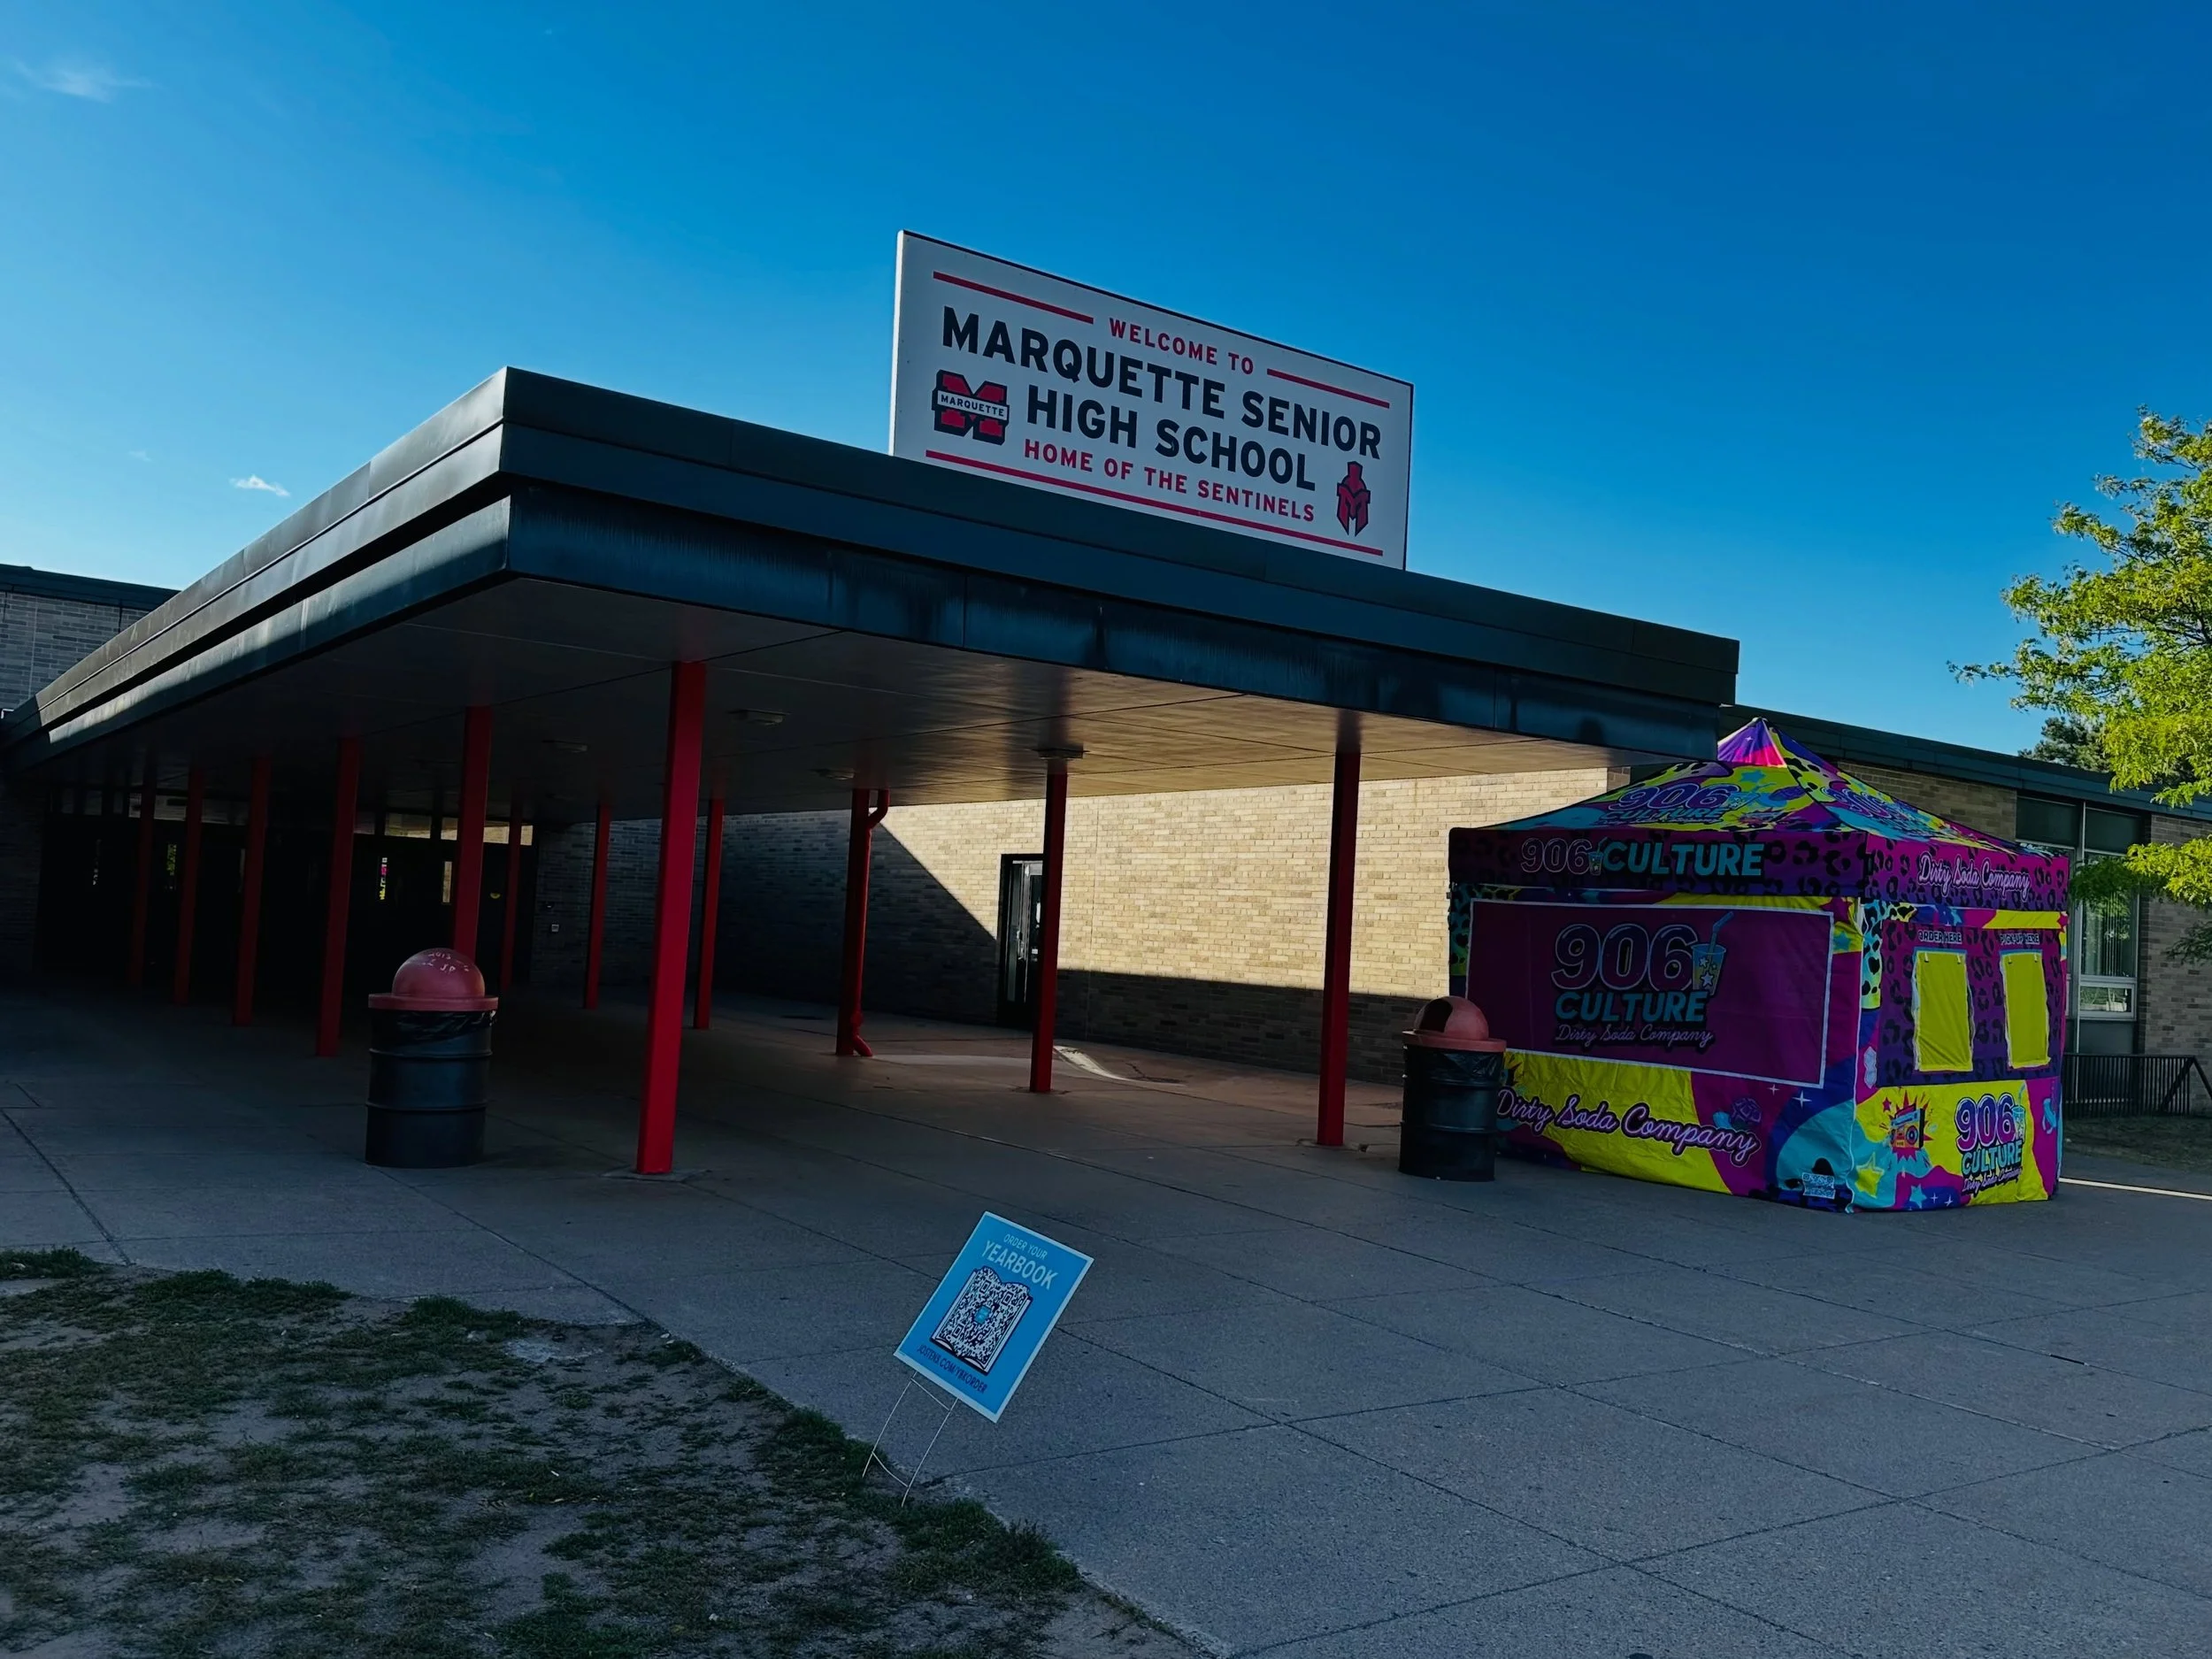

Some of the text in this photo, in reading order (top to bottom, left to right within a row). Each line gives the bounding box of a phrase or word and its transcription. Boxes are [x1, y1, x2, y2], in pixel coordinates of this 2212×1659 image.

[1109, 318, 1254, 375] WELCOME TO
[941, 394, 1004, 417] MARQUETTE
[942, 305, 1381, 459] MARQUETTE SENIOR
[1027, 384, 1316, 491] HIGH SCHOOL
[1025, 439, 1315, 522] HOME OF THE SENTINELS
[1609, 783, 1740, 810] 906
[1520, 836, 1766, 877] 906 CULTURE
[1917, 854, 2031, 900] Dirty Soda Company
[1550, 923, 1698, 991] 906
[1554, 990, 1709, 1022] CULTURE
[1555, 1024, 1714, 1048] Dirty Soda Company
[1495, 1087, 1759, 1163] Dirty Soda Company
[1955, 1094, 2016, 1152] 906
[1962, 1140, 2023, 1176] CULTURE
[980, 1240, 1059, 1291] YEARBOOK
[1003, 1233, 1048, 1260] ORDER YOUR
